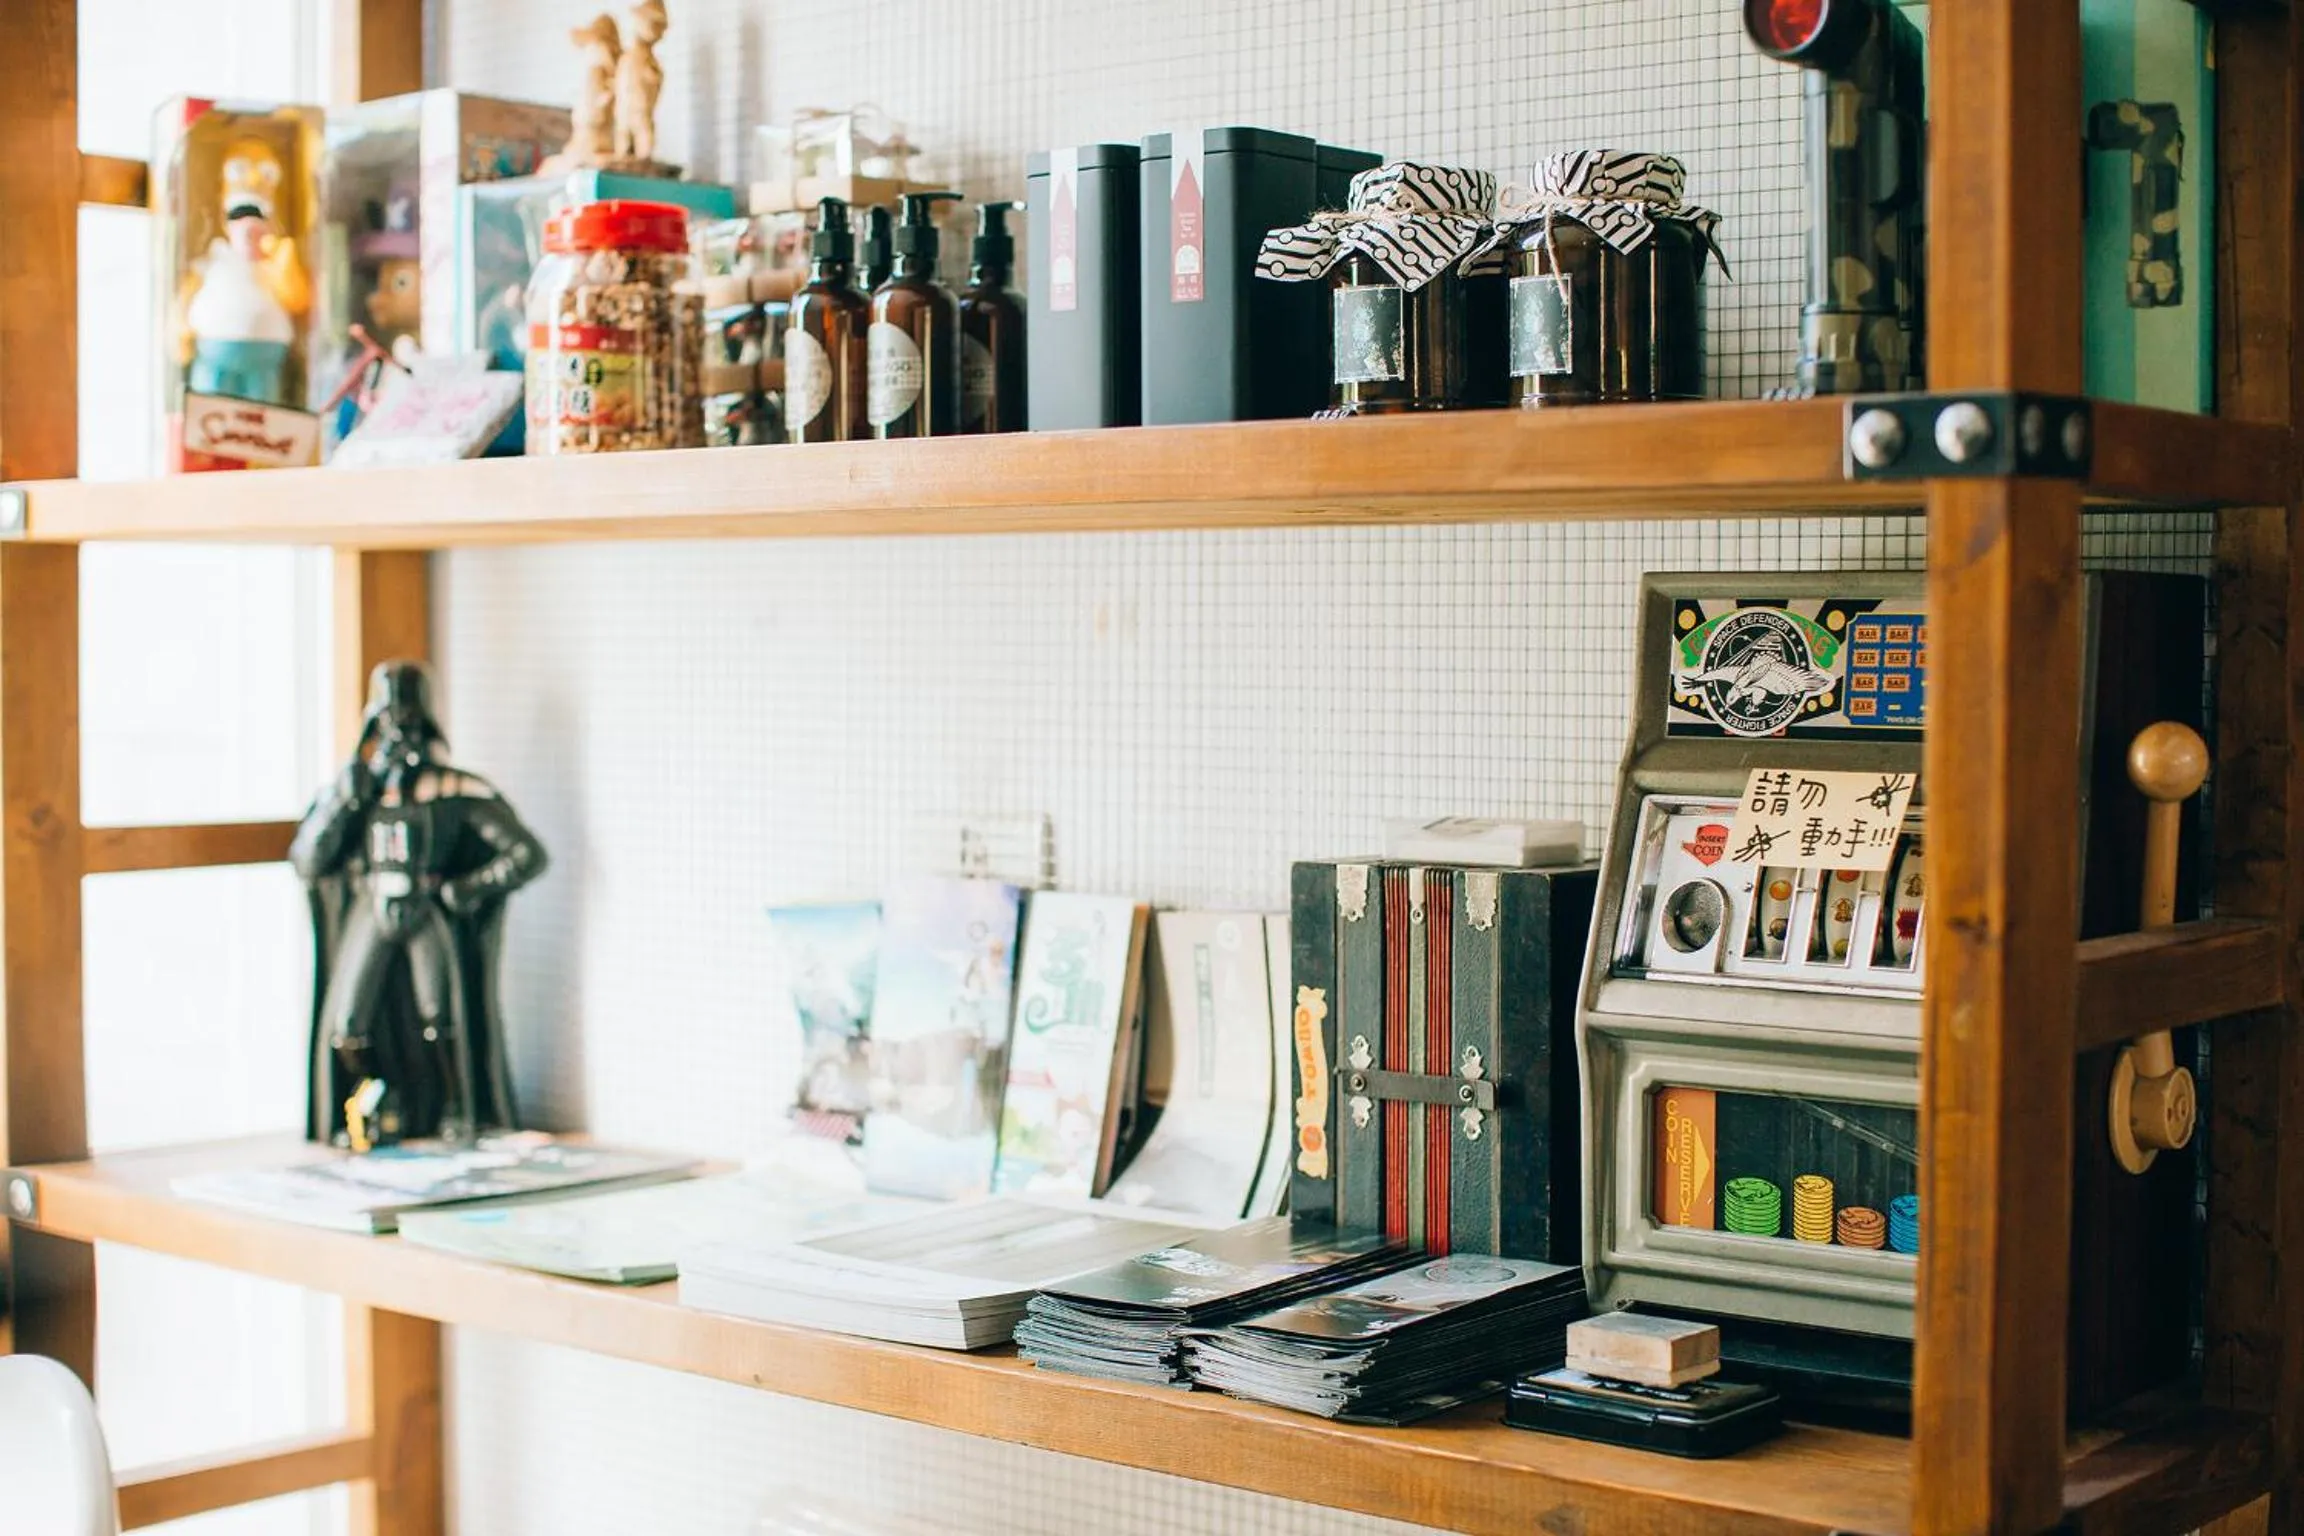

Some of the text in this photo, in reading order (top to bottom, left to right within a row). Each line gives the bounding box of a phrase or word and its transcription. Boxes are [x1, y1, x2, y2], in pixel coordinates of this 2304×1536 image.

[1713, 620, 1740, 649] SPACE
[1740, 613, 1791, 634] DEFENDER
[1725, 701, 1797, 730] SPACE FIGHTER
[1751, 772, 1827, 816] 請勿
[1693, 844, 1725, 856] COIN
[1697, 835, 1726, 843] INSERT
[1665, 1099, 1679, 1164] COIN
[1680, 1118, 1693, 1227] RESERVE
